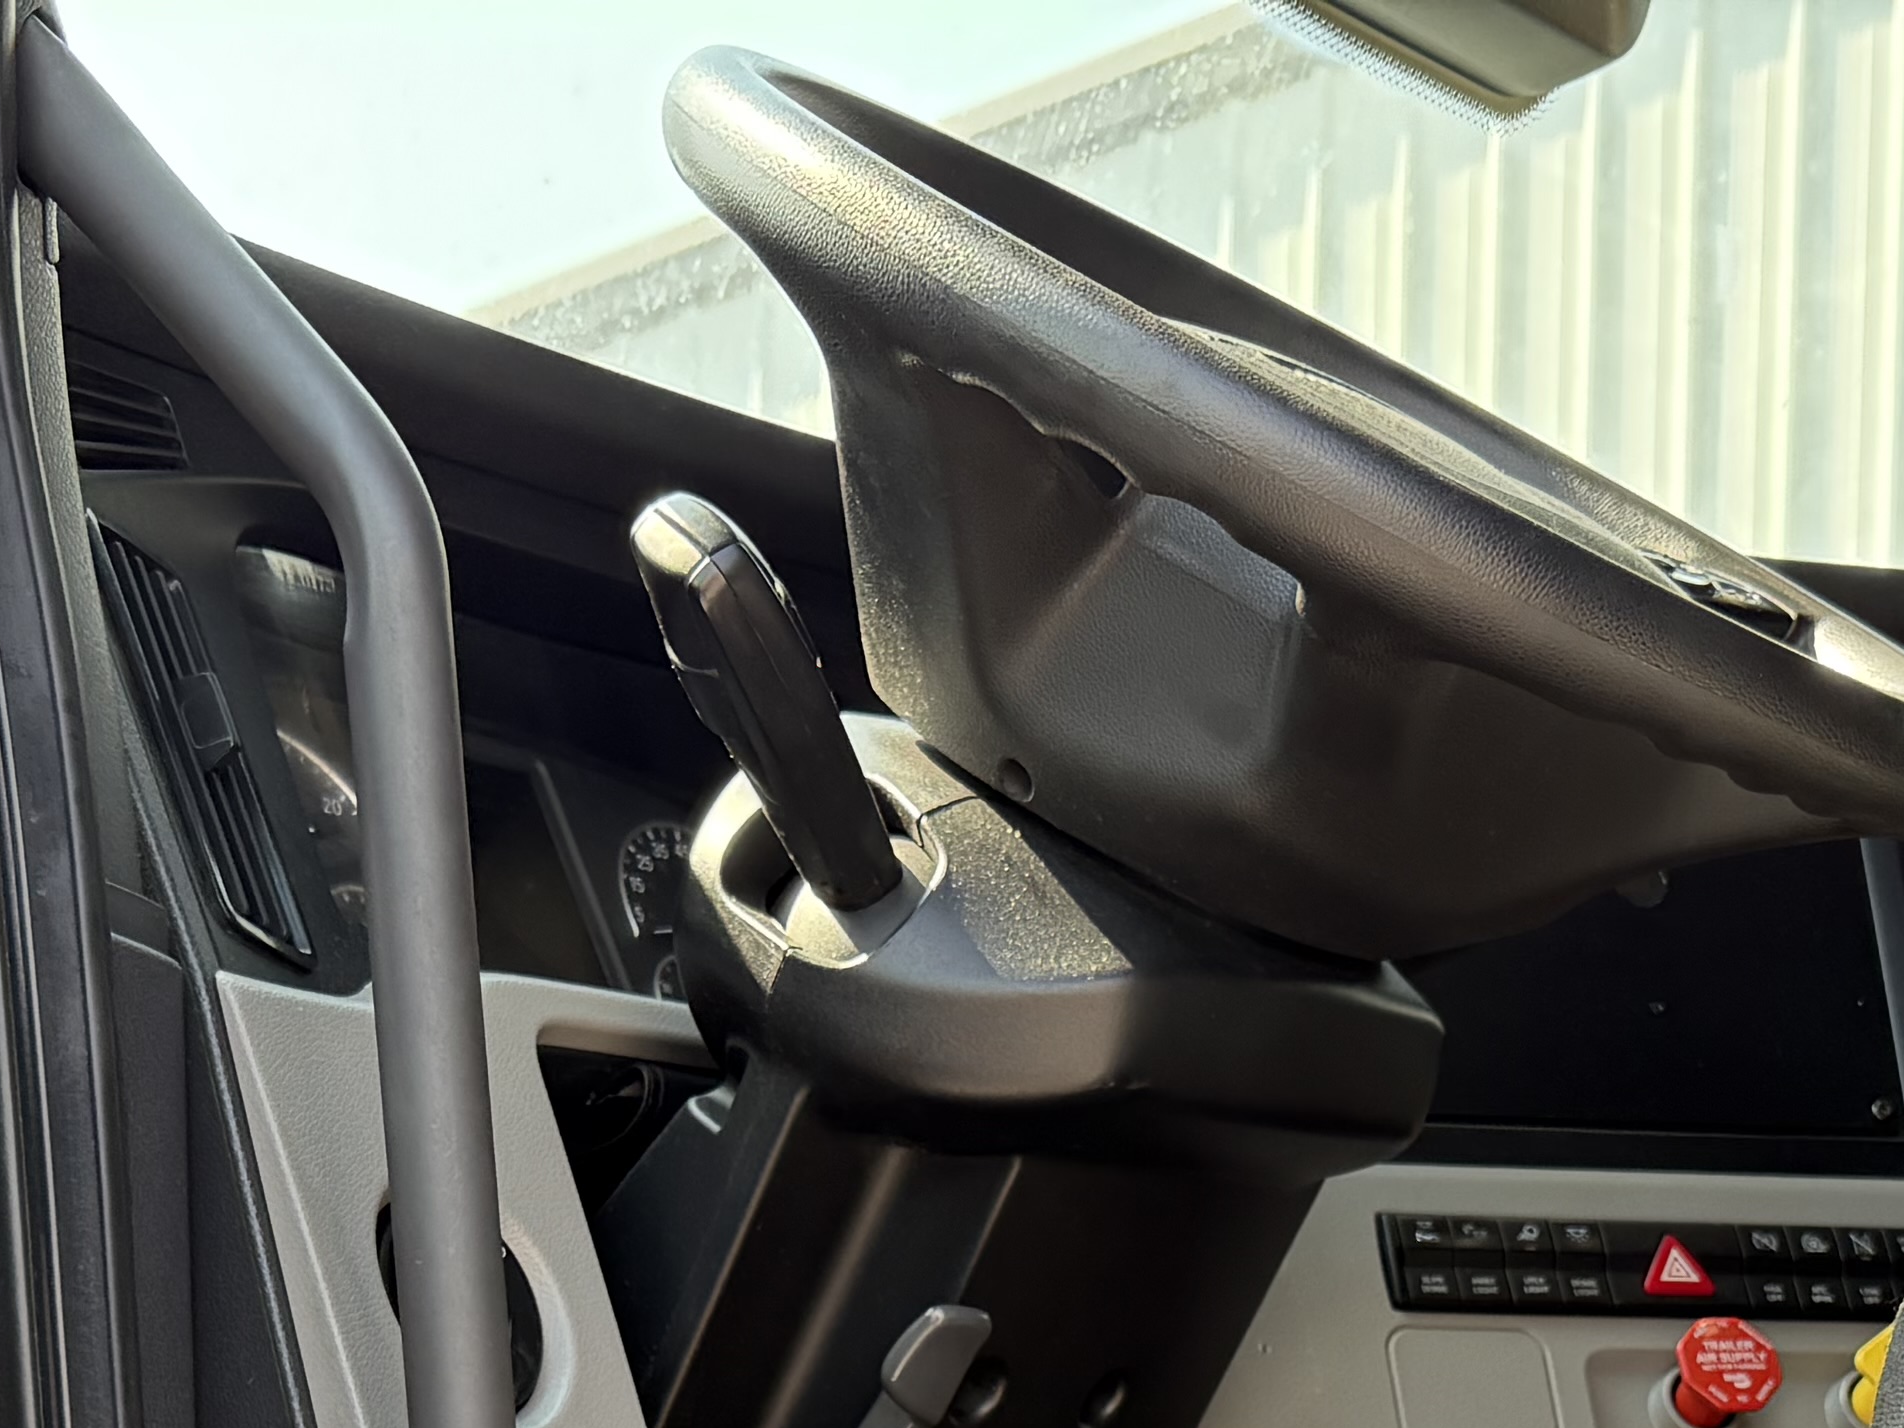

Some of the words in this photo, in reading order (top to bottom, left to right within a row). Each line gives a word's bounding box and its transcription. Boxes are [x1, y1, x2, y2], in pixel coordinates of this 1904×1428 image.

[323, 797, 342, 816] 20
[636, 854, 654, 872] 25
[634, 905, 645, 923] 5
[1703, 1340, 1754, 1352] TRAILER
[1697, 1352, 1717, 1364] AIR
[1719, 1351, 1767, 1363] SUPPLY
